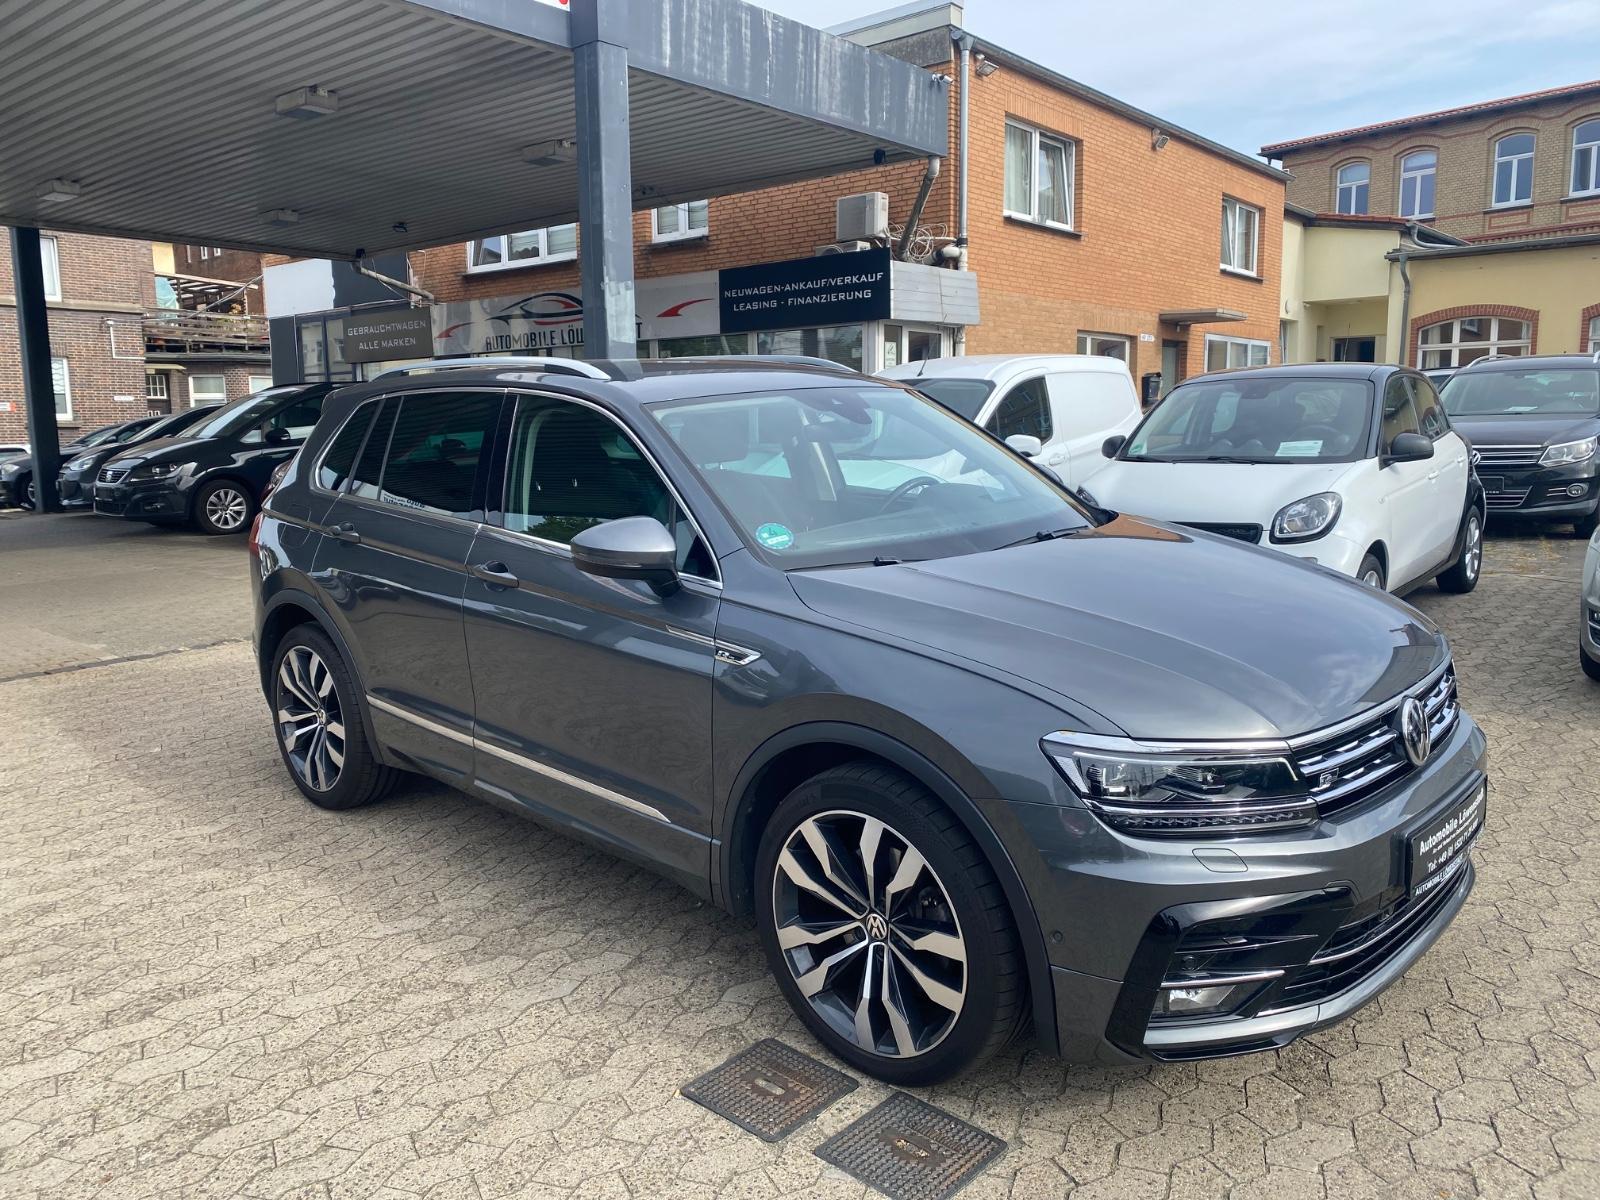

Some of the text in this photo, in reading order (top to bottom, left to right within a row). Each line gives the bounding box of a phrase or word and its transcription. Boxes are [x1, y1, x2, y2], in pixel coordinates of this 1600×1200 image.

[724, 272, 884, 298] NEUWAGEN-ANKAUF/VERKAUF
[733, 300, 777, 312] LEASING
[788, 289, 872, 306] FINANZIERUNG
[347, 320, 426, 336] GEBRAUCHTWAGEN
[359, 337, 416, 350] ALLE MARKEN
[486, 330, 556, 351] AUTOMOBILE
[1420, 817, 1458, 856] Automobile
